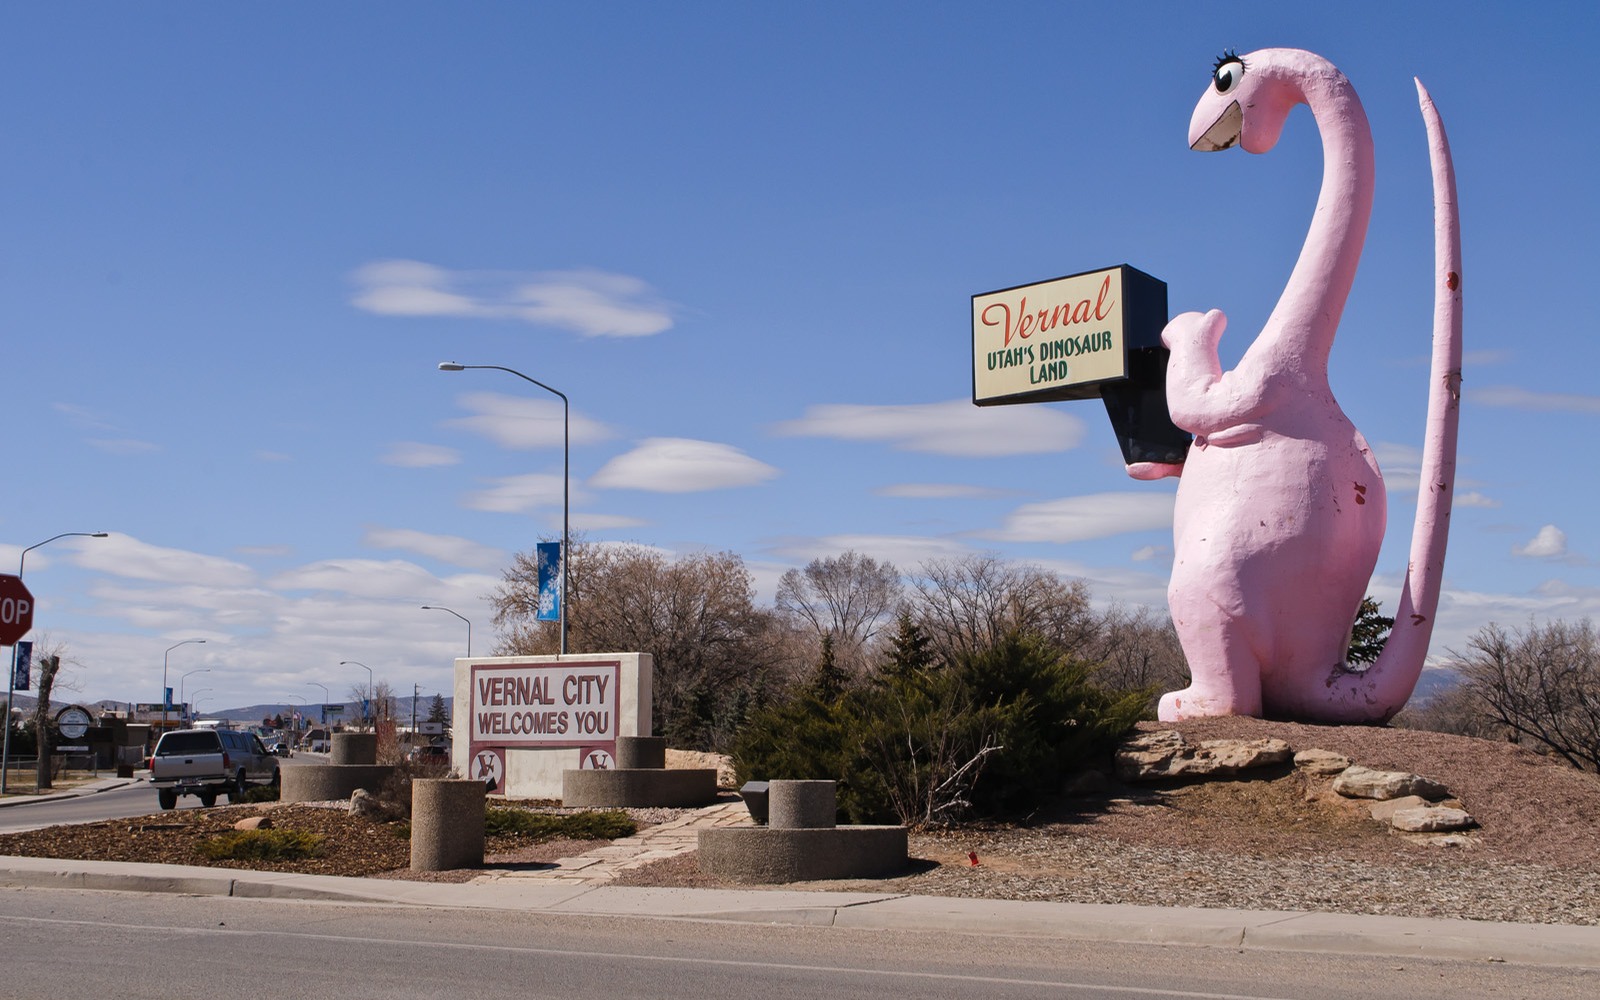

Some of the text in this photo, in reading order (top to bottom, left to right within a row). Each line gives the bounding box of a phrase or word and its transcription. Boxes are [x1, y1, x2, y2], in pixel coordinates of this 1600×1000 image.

[981, 274, 1115, 347] Vernal
[987, 331, 1112, 371] UTAH'S DINOSAUR
[1030, 360, 1068, 385] LAND
[0, 597, 30, 624] OP
[479, 674, 610, 706] VERNAL CITY
[478, 710, 609, 735] WELCOMES YOU
